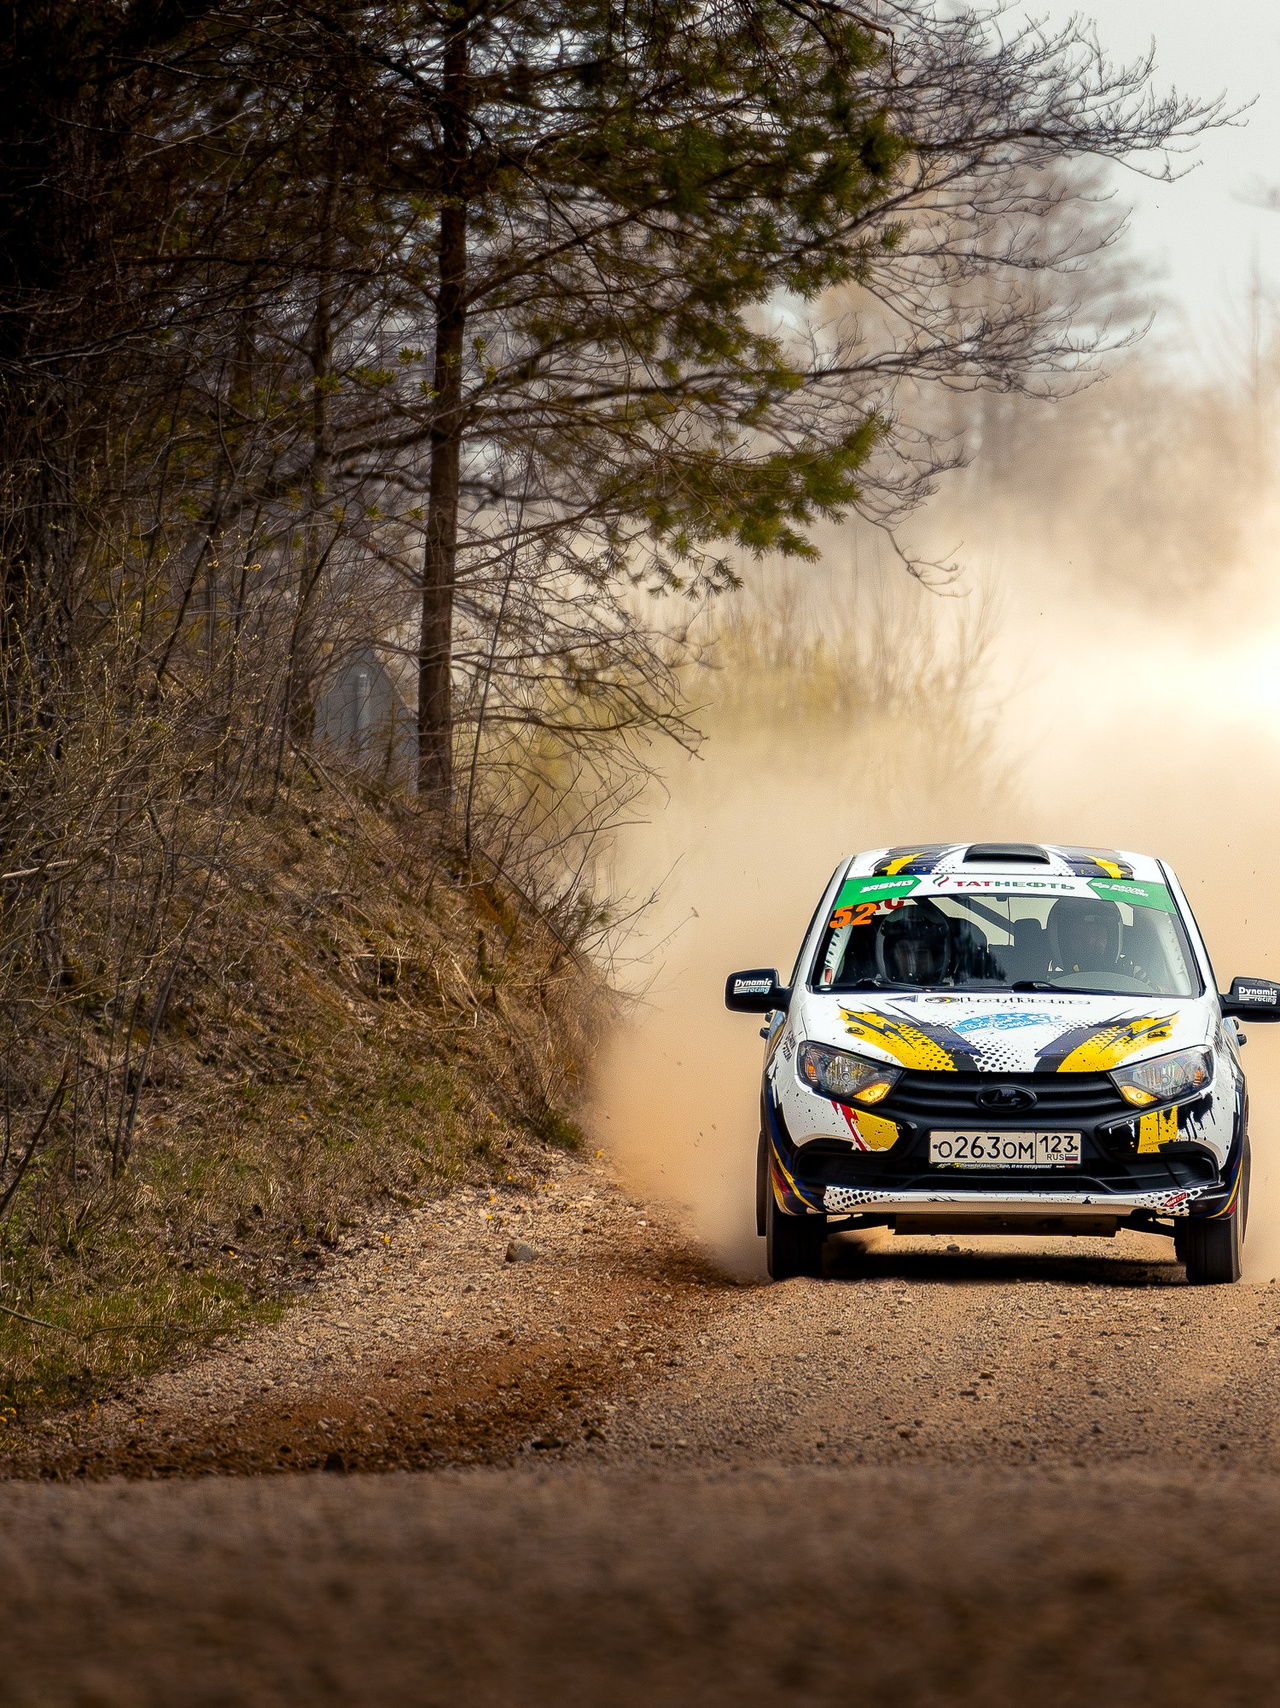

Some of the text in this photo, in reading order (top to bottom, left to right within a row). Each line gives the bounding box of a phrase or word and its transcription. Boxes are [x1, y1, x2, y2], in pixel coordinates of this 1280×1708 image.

[953, 881, 1075, 890] ТАТНЕФТЬ
[829, 903, 877, 928] 52
[735, 978, 773, 988] Dynamic
[1238, 986, 1277, 996] Dynamic
[1254, 996, 1277, 1005] racing
[938, 1135, 1074, 1159] О263ОМ 123
[1046, 1153, 1065, 1161] RUS
